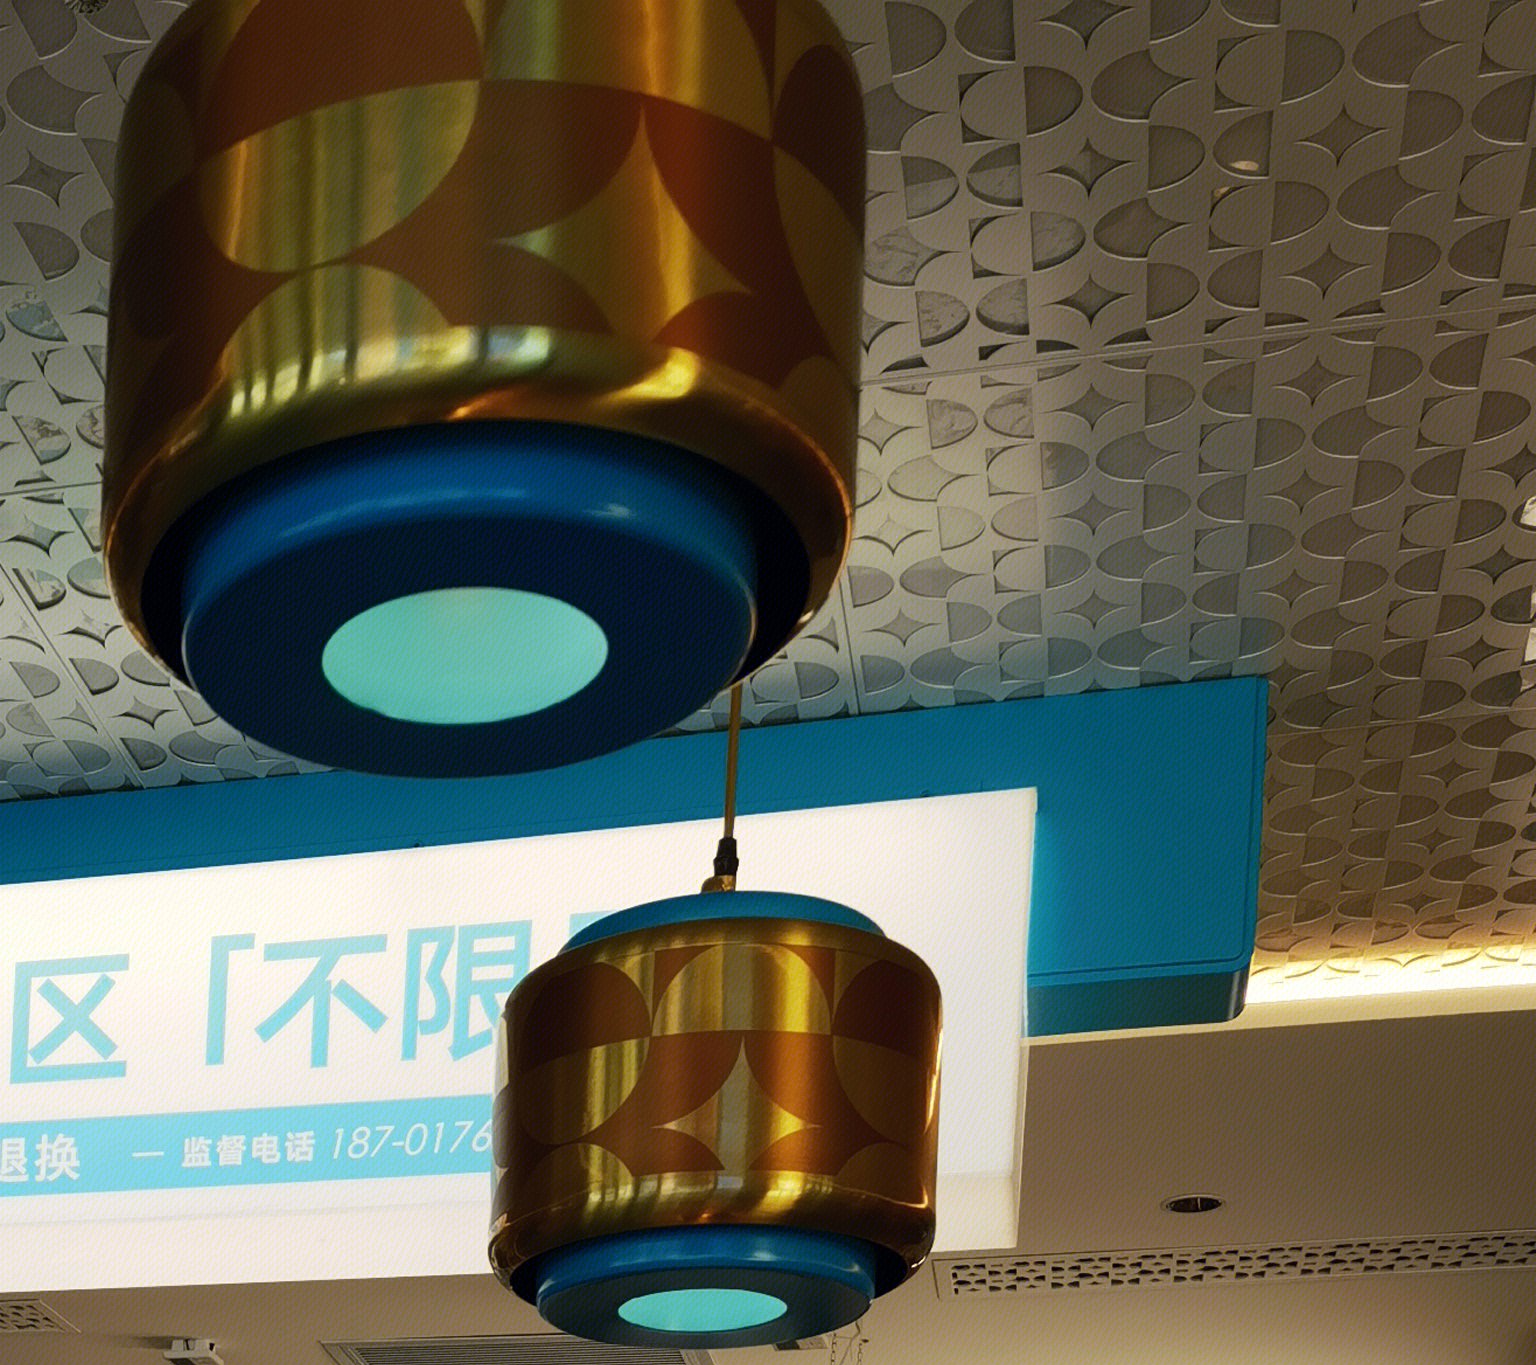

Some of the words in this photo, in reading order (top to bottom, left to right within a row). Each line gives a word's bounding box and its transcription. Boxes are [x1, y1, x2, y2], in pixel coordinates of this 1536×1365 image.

[205, 910, 618, 1069] 「不限
[180, 1130, 315, 1168] 监督电话
